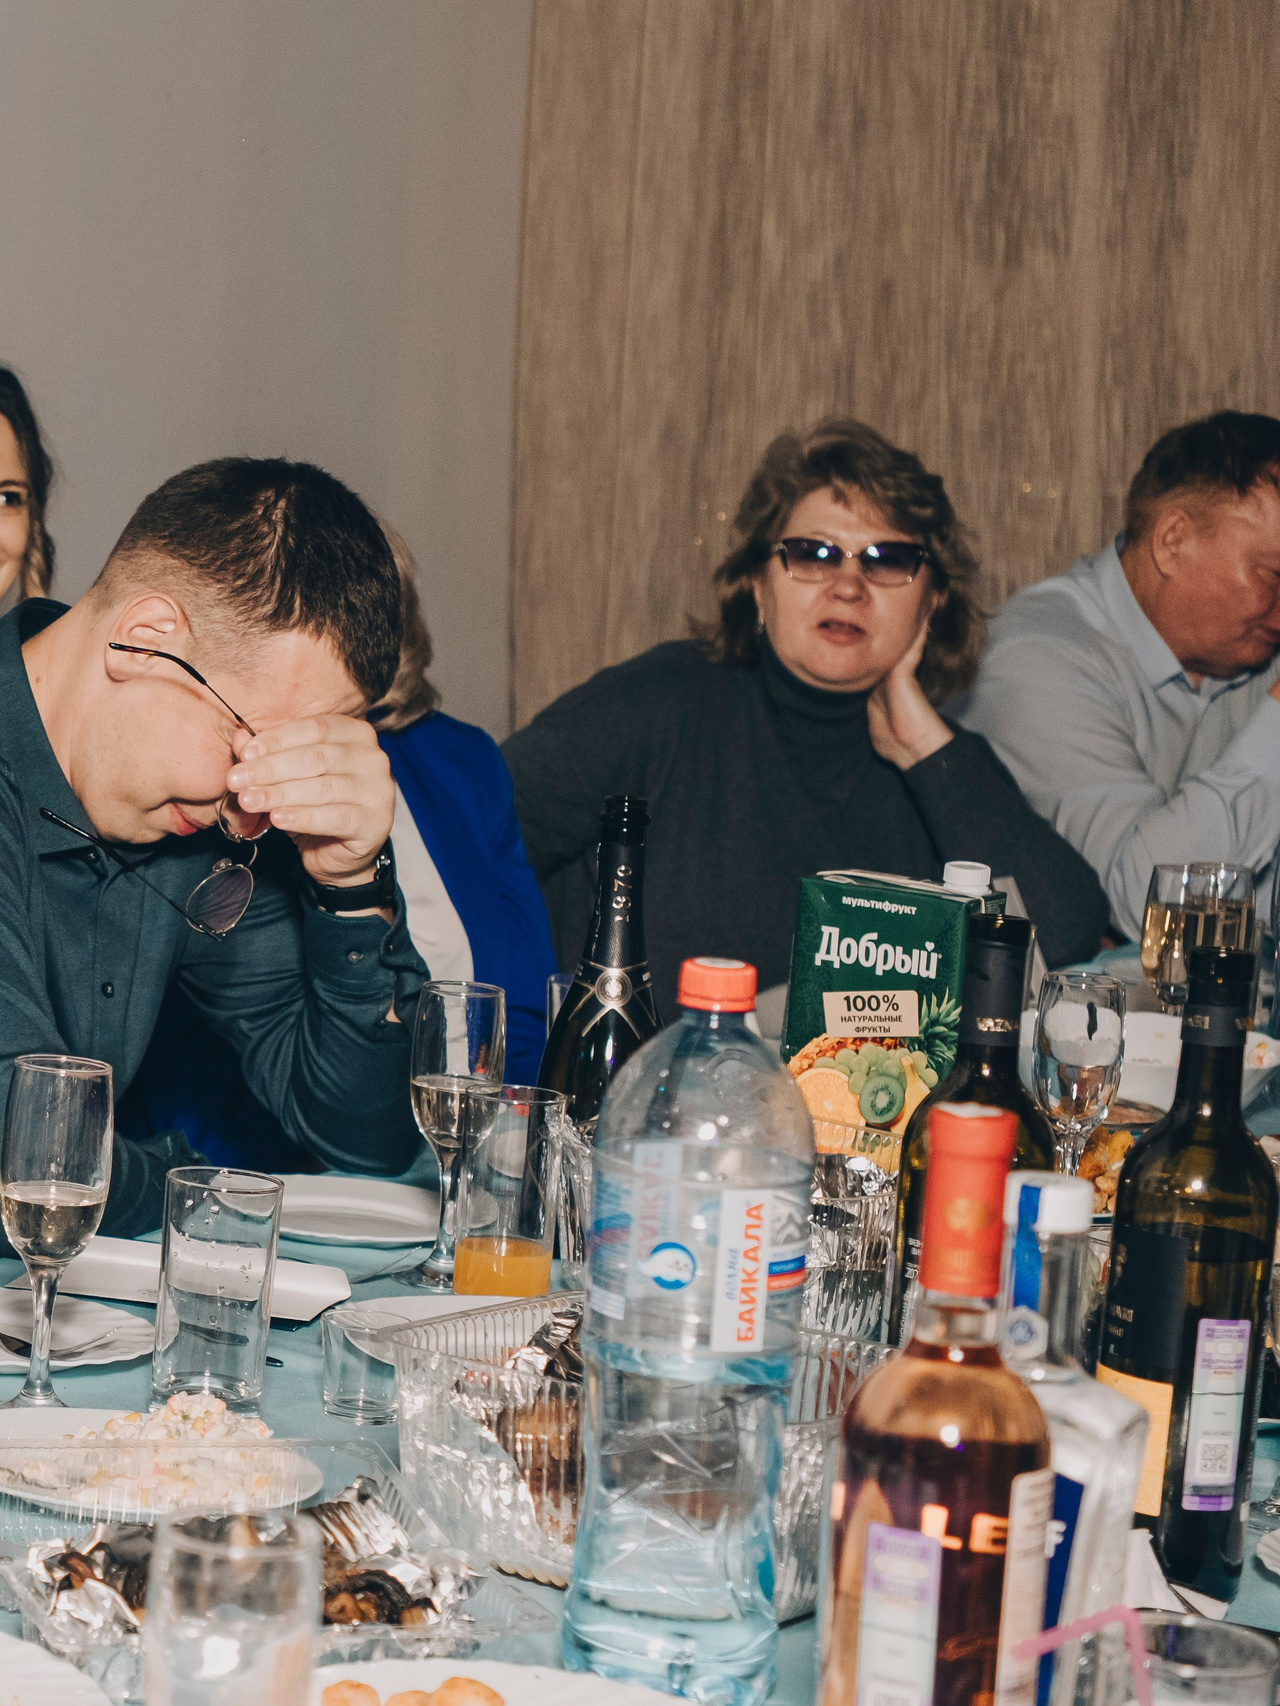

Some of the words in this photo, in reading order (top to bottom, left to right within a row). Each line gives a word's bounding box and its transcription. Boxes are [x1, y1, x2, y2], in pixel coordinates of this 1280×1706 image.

[842, 896, 918, 915] мультифрукт
[814, 925, 938, 980] Добрый
[843, 994, 900, 1013] 100%
[840, 1014, 904, 1024] НАТУРАЛЬНЫЕ
[854, 1025, 891, 1035] ФРУКТЫ
[736, 1202, 765, 1343] БАЙКАЛА
